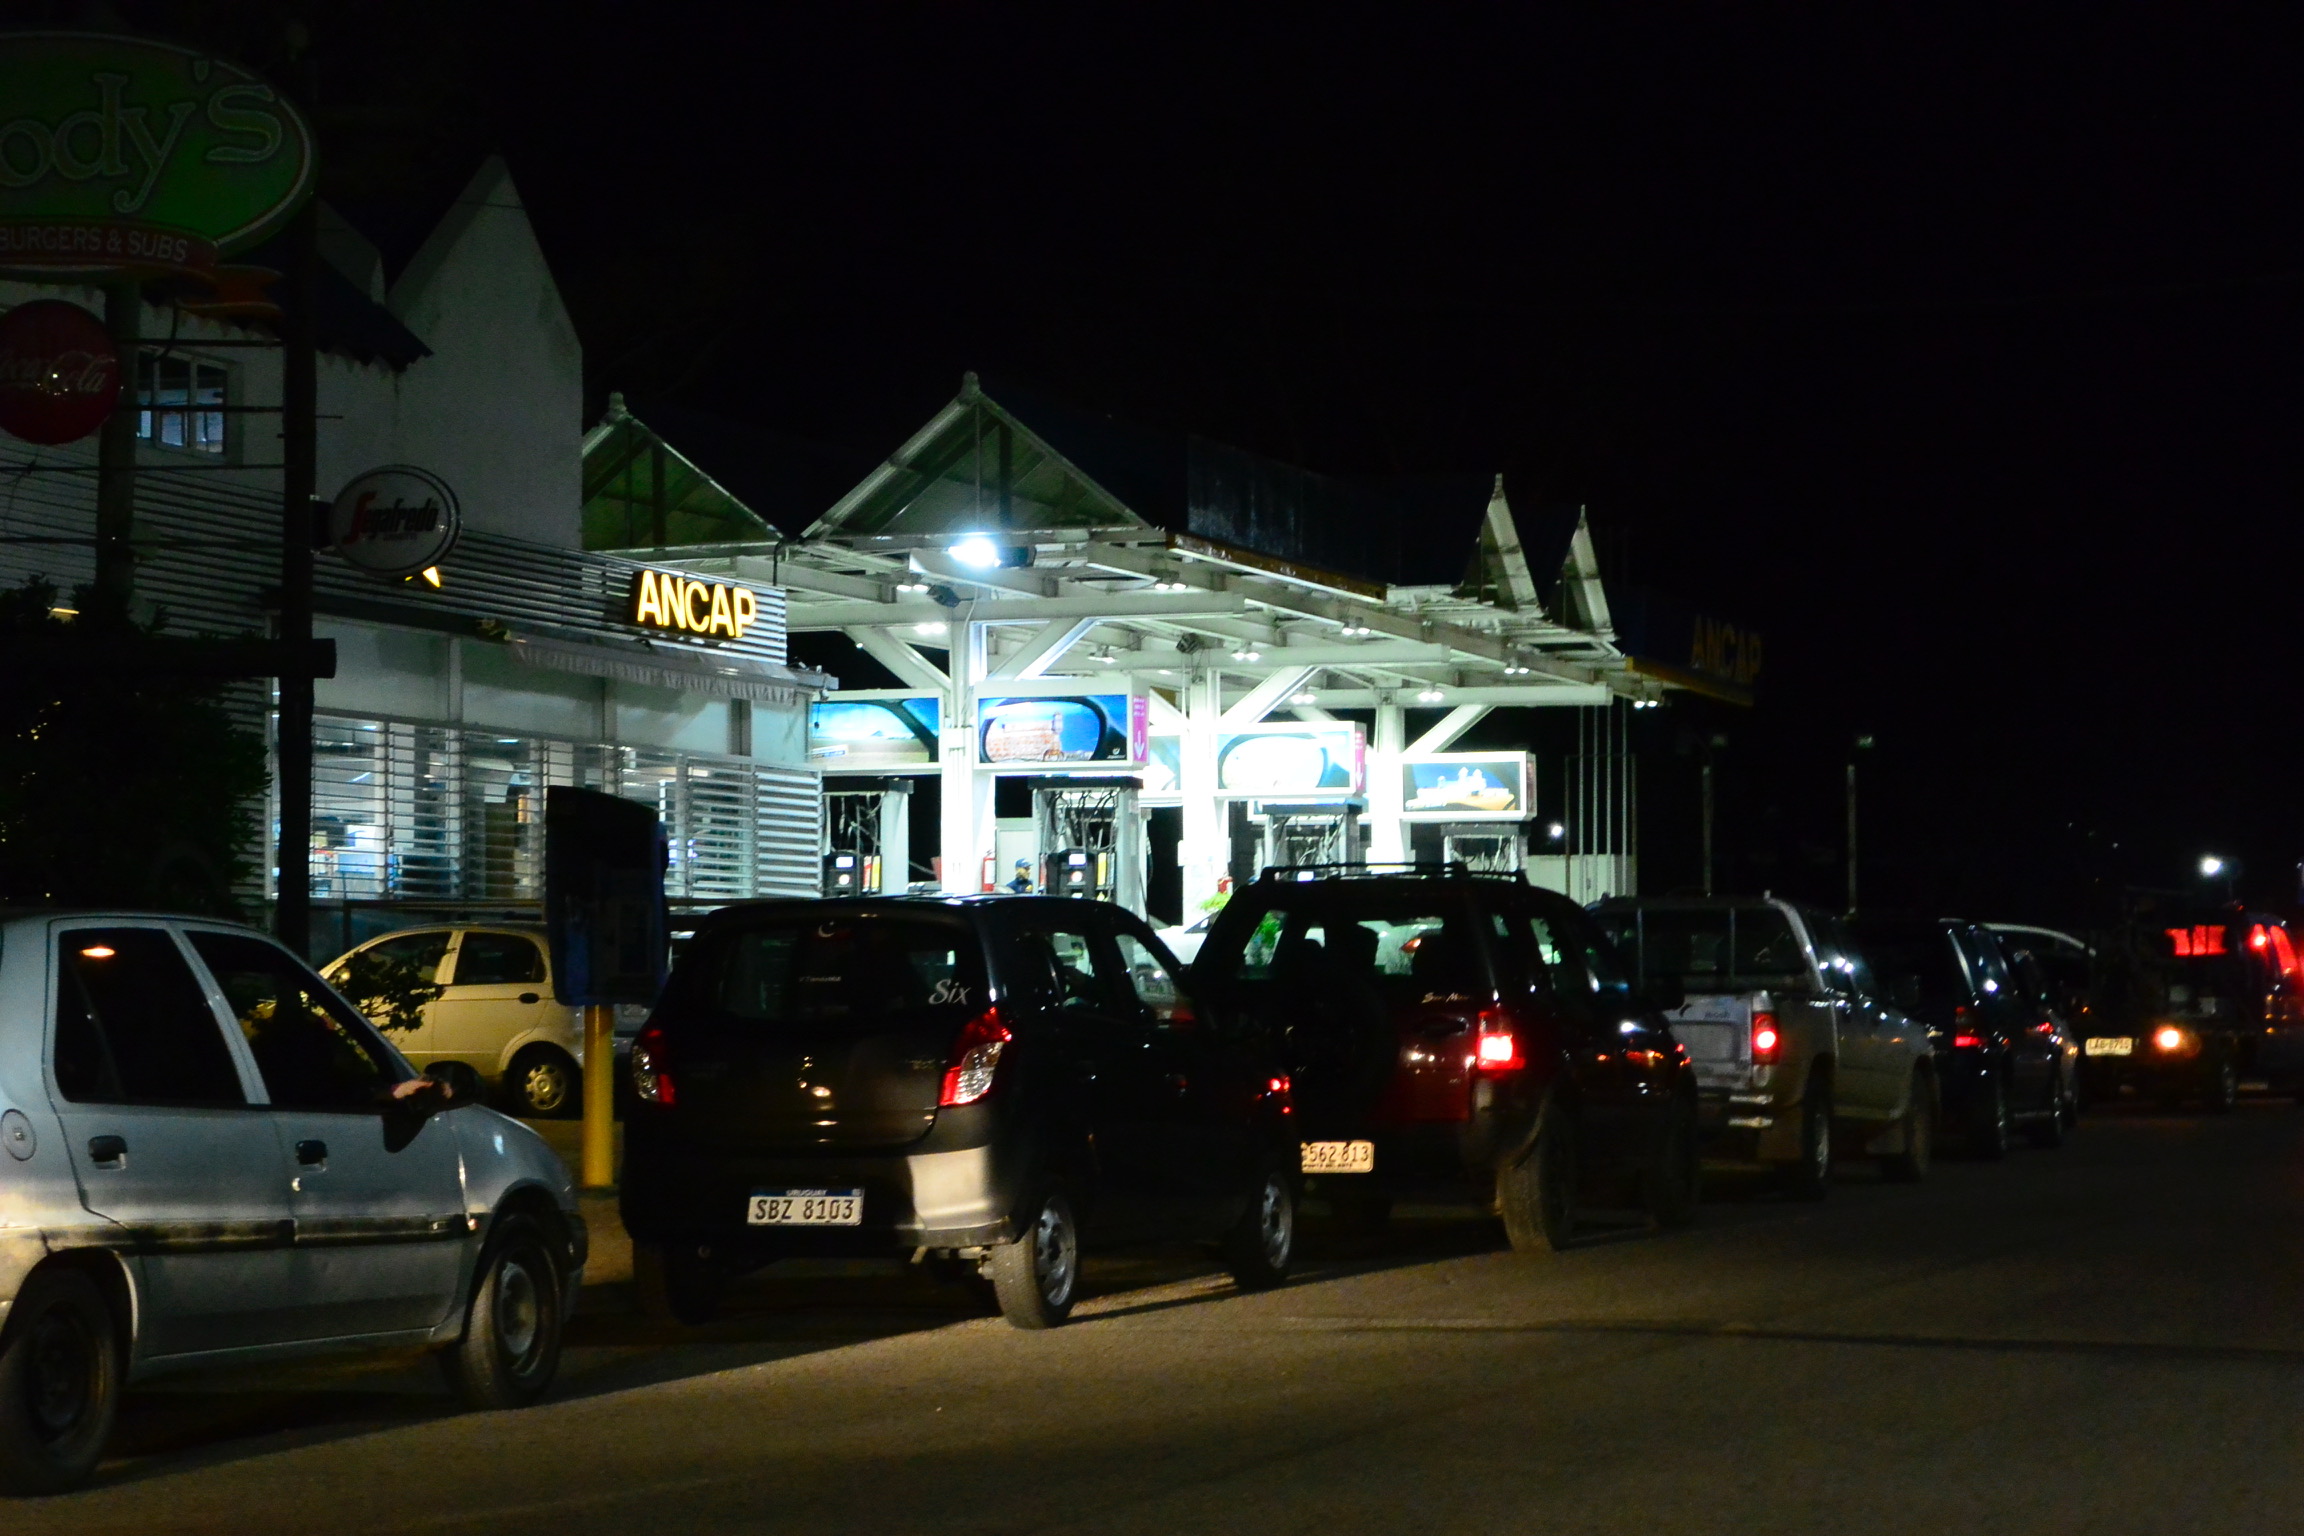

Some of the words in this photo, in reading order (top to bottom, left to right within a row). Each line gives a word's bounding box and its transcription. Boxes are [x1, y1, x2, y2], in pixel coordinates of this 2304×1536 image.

[0, 226, 102, 251] BURGERS
[107, 228, 123, 254] &
[127, 230, 189, 263] SUBS
[637, 569, 757, 638] ANCAP
[1689, 613, 1763, 685] ANCAP
[928, 978, 972, 1005] Six
[755, 1199, 793, 1220] SBZ
[803, 1199, 854, 1220] 8103
